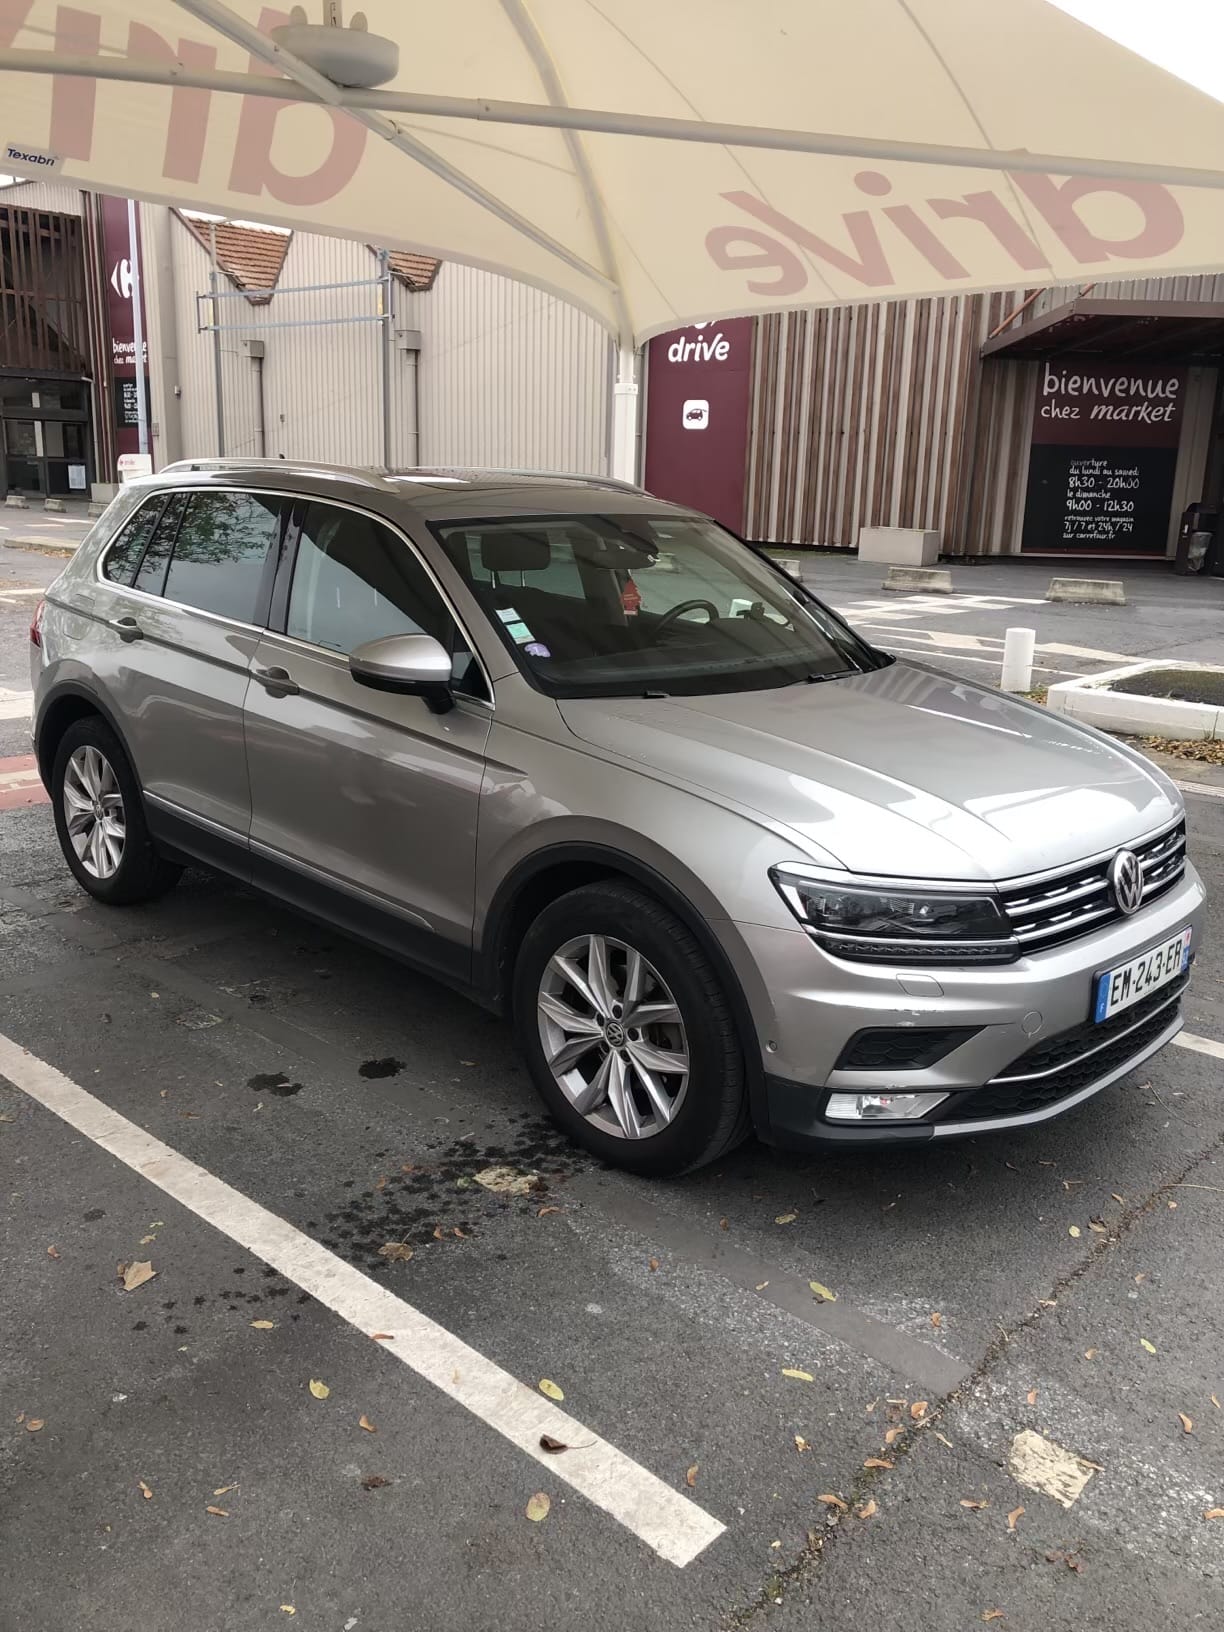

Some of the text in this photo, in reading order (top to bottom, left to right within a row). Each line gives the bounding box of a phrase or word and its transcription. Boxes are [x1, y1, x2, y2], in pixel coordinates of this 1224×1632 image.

[667, 332, 730, 363] drive
[1043, 362, 1179, 398] bienvenue
[1040, 399, 1176, 424] chez market
[1069, 465, 1080, 475] du
[1082, 465, 1101, 475] lundi
[1115, 466, 1140, 476] samedi
[1068, 475, 1095, 488] 8h30
[1107, 477, 1140, 489] 20h00
[1067, 489, 1111, 499] le dimanche
[1066, 499, 1092, 511] 9h00
[1104, 500, 1135, 512] 12h30
[1064, 521, 1072, 532] 7j
[1087, 523, 1096, 531] et
[1098, 522, 1113, 531] 24h
[1122, 522, 1133, 533] 24
[1076, 530, 1116, 540] carrefour.fr
[1099, 1002, 1105, 1013] F
